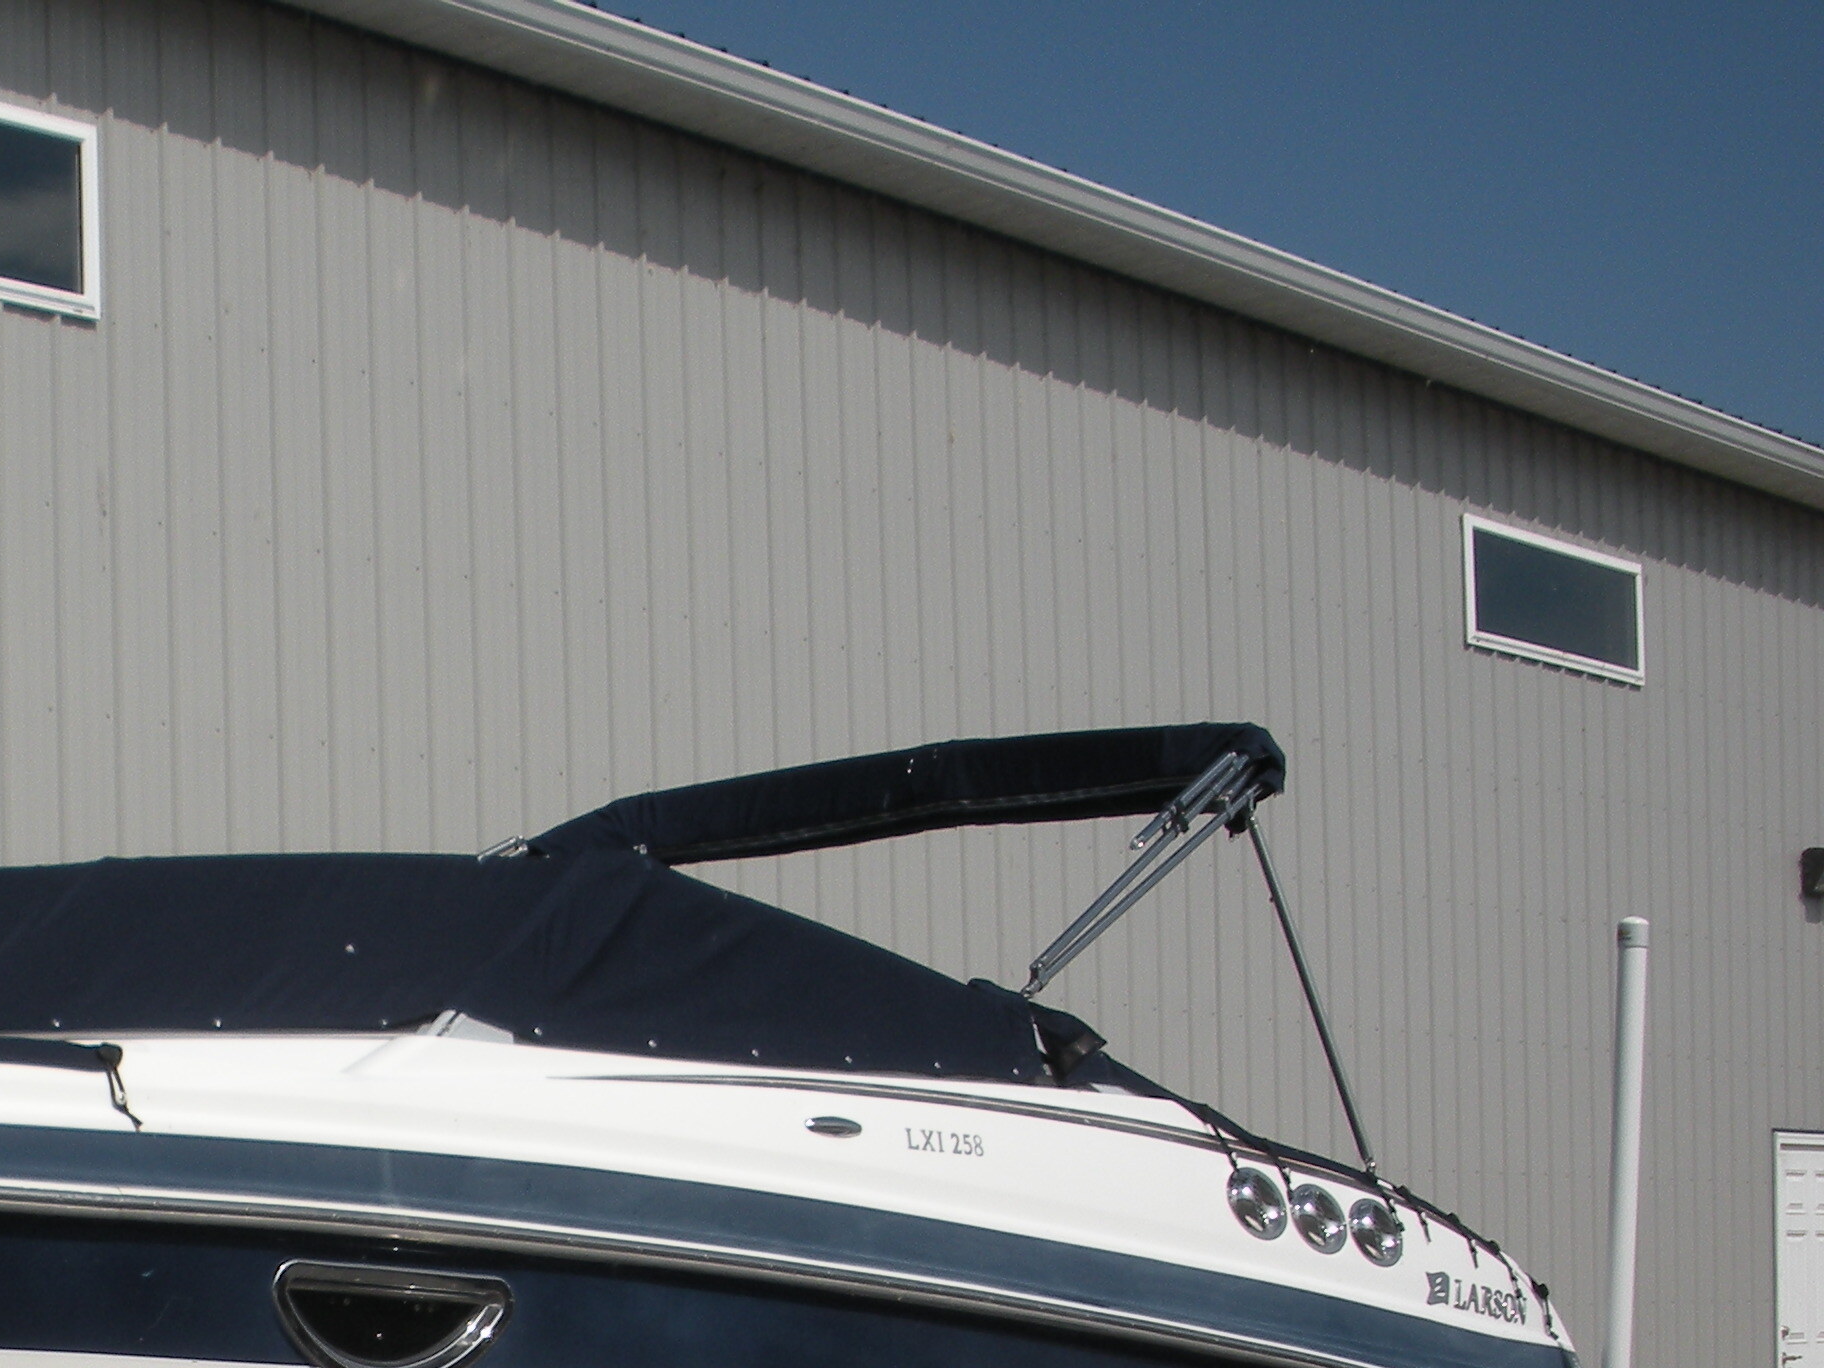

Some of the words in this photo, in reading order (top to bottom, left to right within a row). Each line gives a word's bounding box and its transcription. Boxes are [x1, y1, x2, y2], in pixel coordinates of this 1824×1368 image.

[905, 1128, 945, 1153] LXI
[950, 1132, 985, 1157] 258
[1453, 1279, 1527, 1326] LARSON
